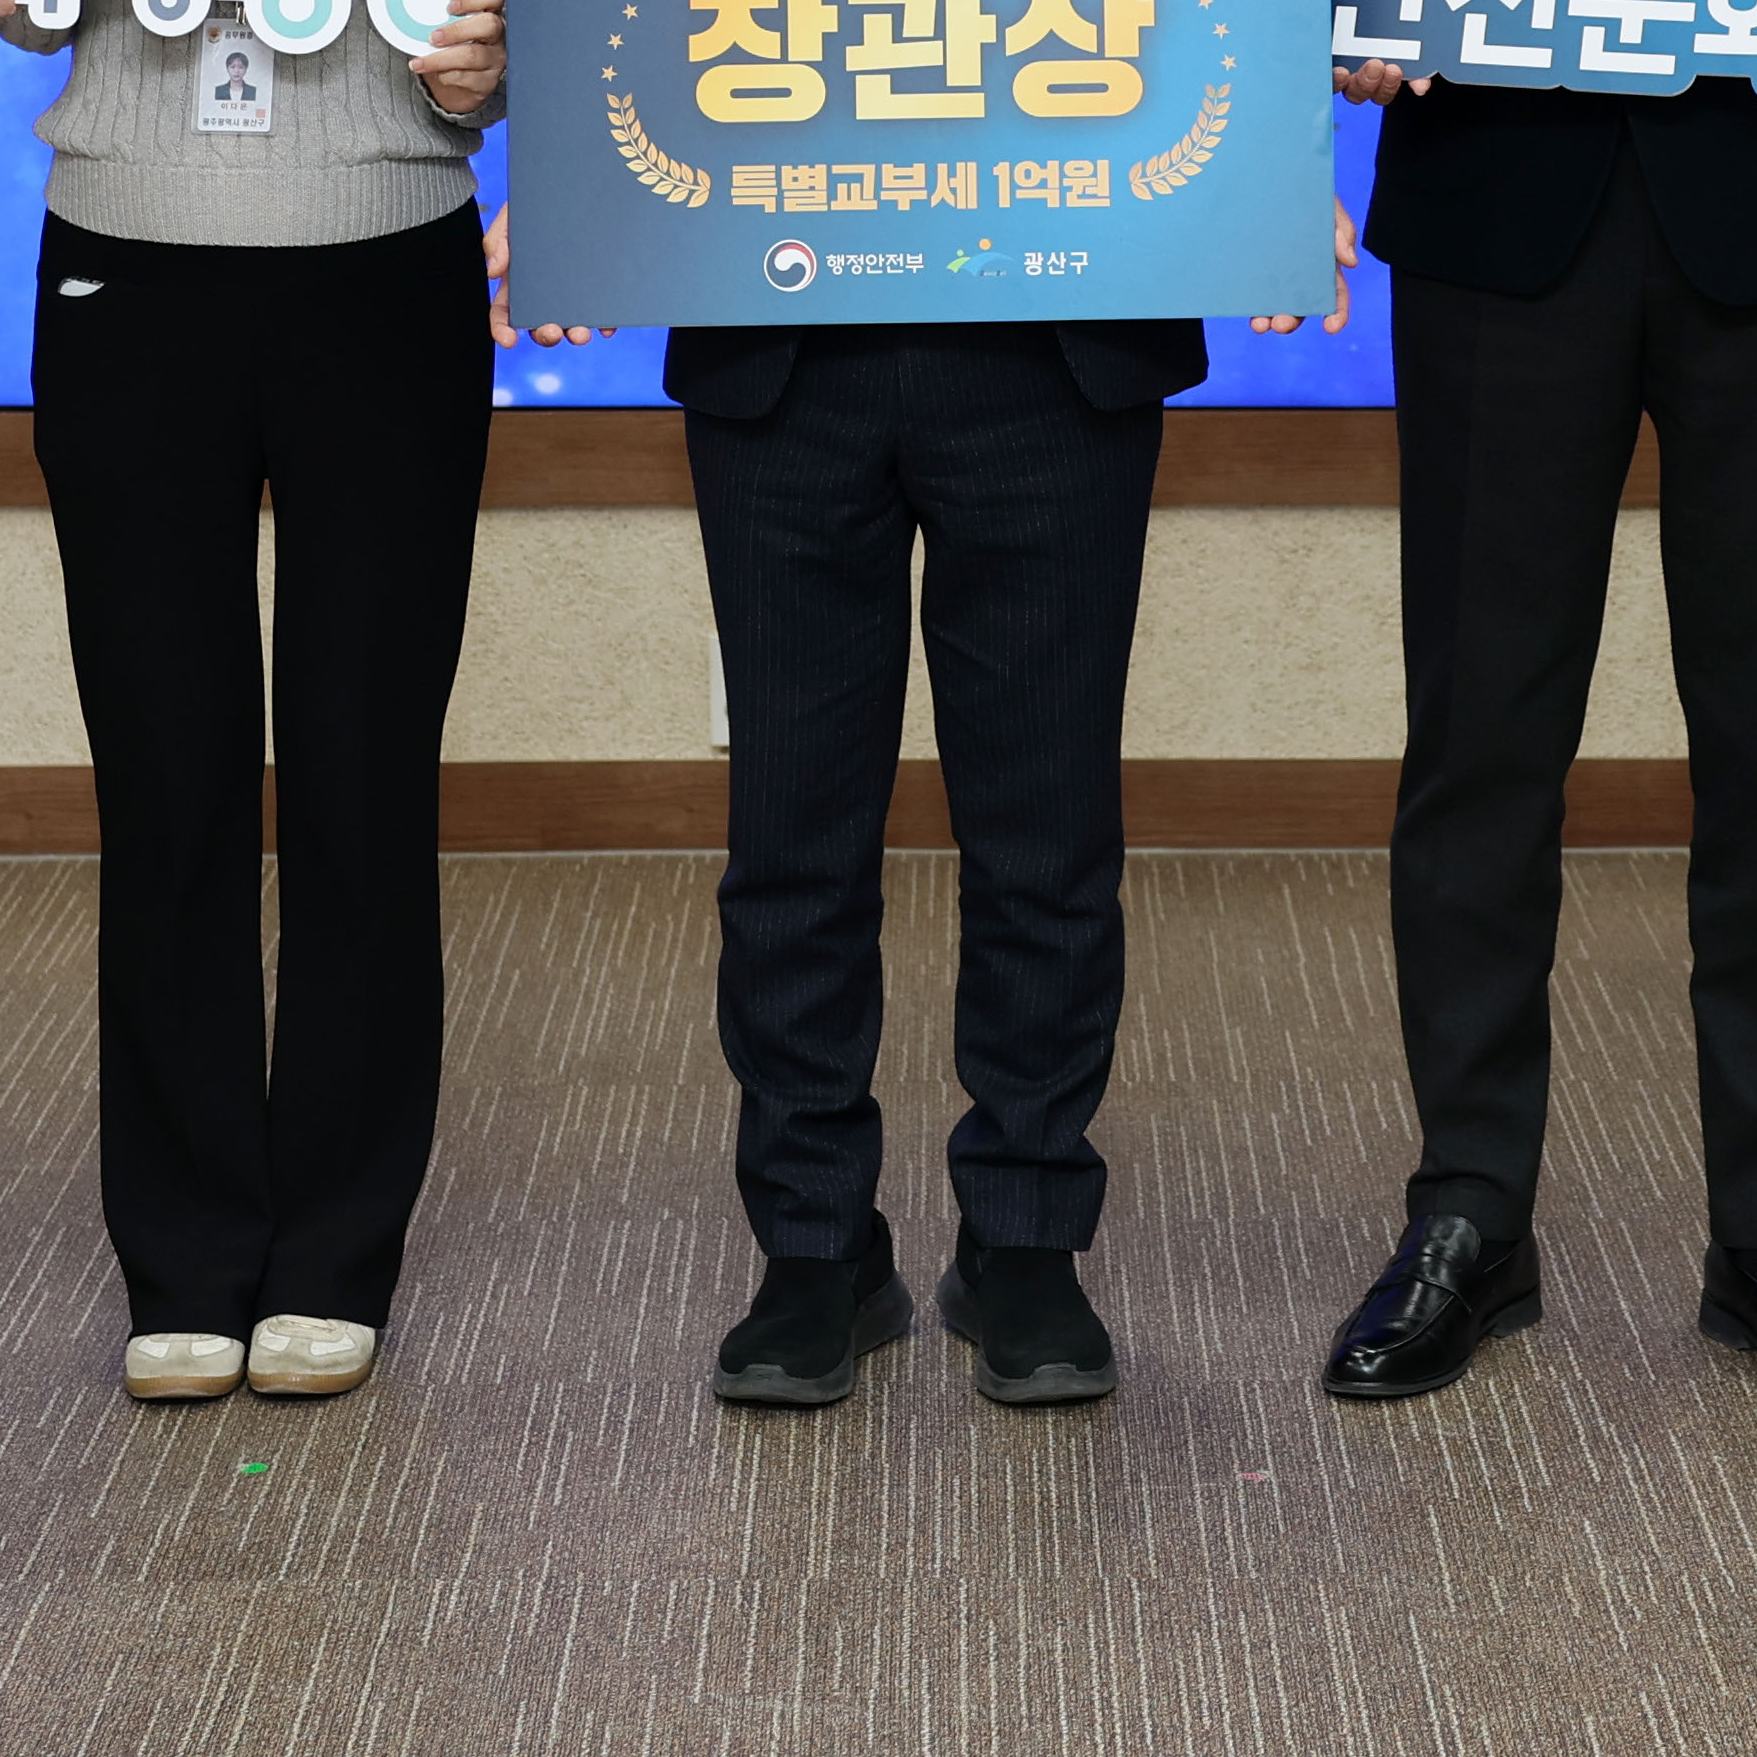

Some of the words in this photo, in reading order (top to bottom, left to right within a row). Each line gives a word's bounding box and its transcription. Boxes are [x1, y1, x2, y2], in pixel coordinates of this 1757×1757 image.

[730, 162, 978, 213] 특별교부세
[994, 160, 1111, 208] 1억원
[825, 253, 925, 276] 행정안전부
[1023, 251, 1089, 276] 광산구
